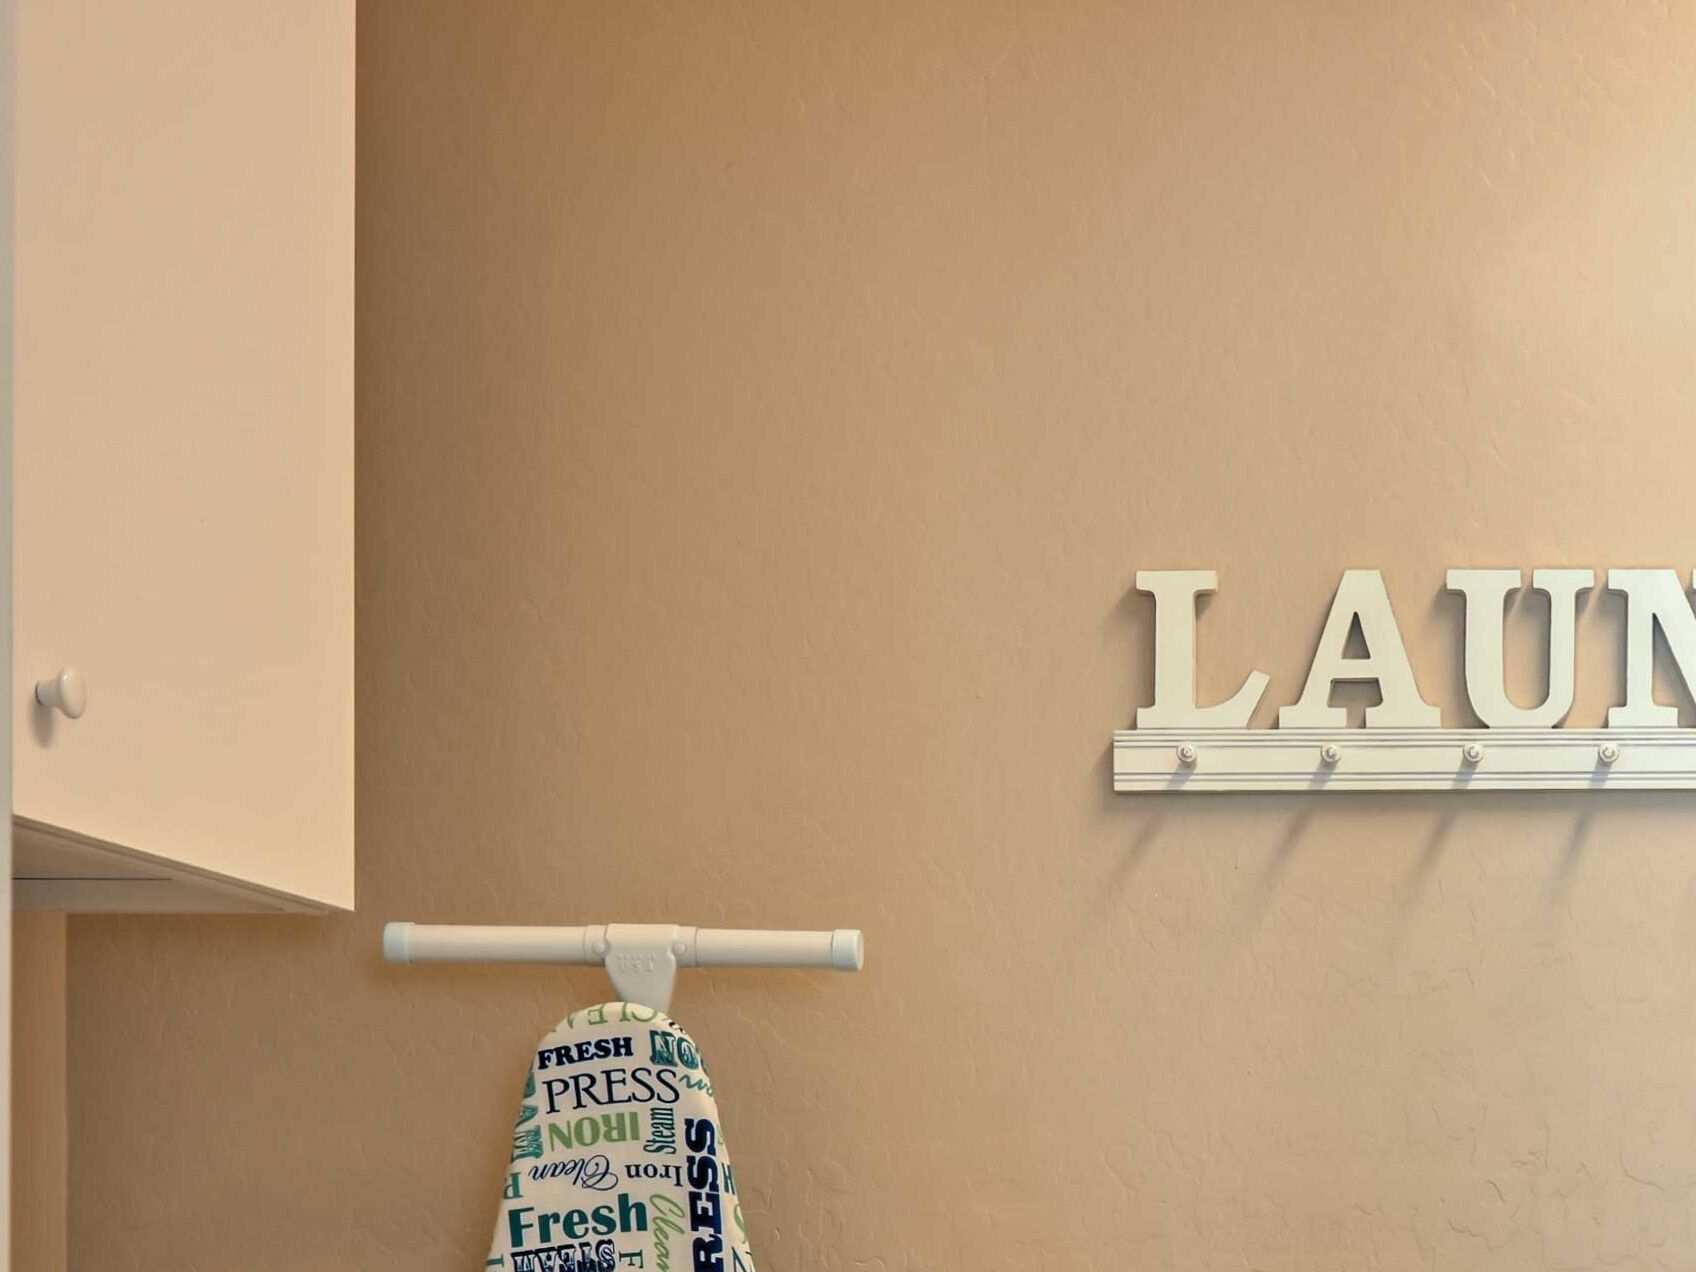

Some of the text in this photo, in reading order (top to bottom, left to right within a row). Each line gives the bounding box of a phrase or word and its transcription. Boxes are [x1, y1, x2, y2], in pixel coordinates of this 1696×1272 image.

[538, 1036, 633, 1070] FRESH
[542, 1067, 680, 1114] PRESS
[547, 1112, 639, 1152] IRON
[642, 1107, 677, 1155] Steam
[528, 1155, 619, 1191] Clean
[624, 1163, 684, 1187] Iron
[508, 1192, 648, 1248] Fresh
